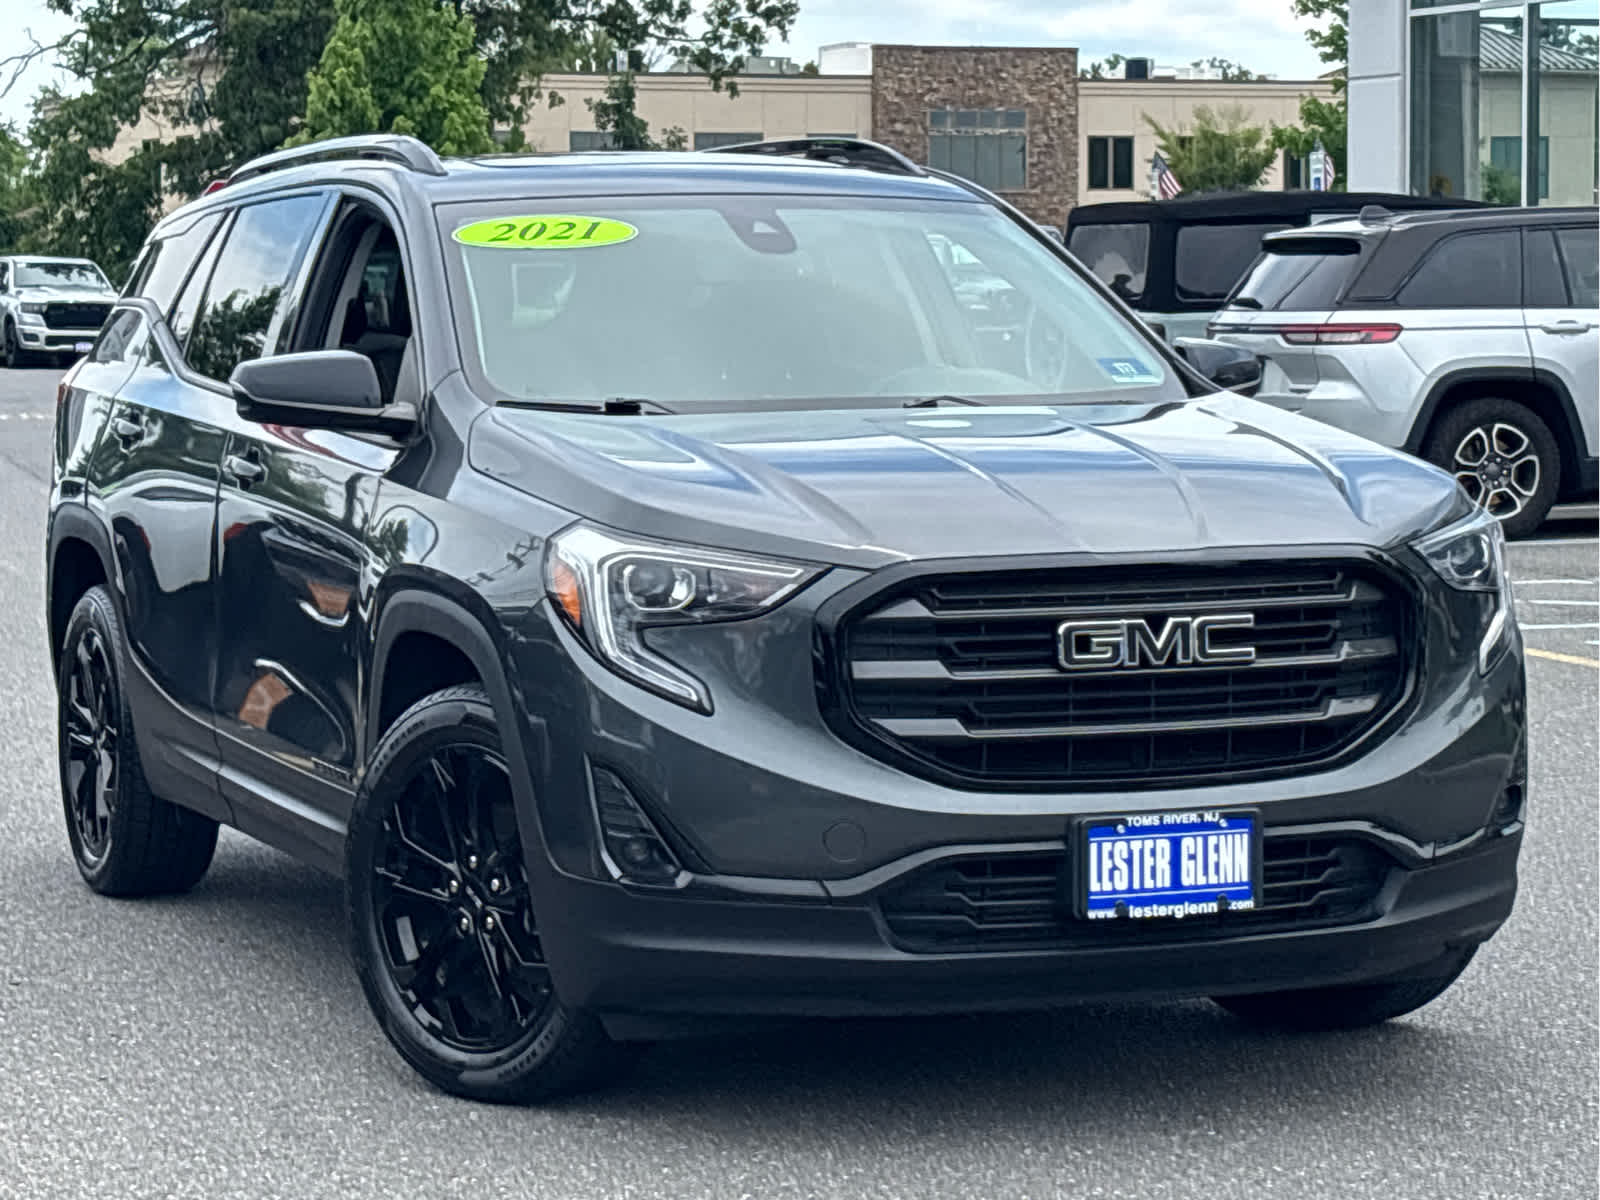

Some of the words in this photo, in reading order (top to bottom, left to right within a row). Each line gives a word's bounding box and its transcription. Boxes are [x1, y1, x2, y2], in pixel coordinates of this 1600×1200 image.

[487, 221, 602, 242] 2021
[1058, 613, 1256, 669] GMC
[1127, 815, 1160, 827] TOMS
[1203, 811, 1220, 822] NJ
[1089, 838, 1171, 892] LESTER
[1180, 833, 1249, 886] GLENN
